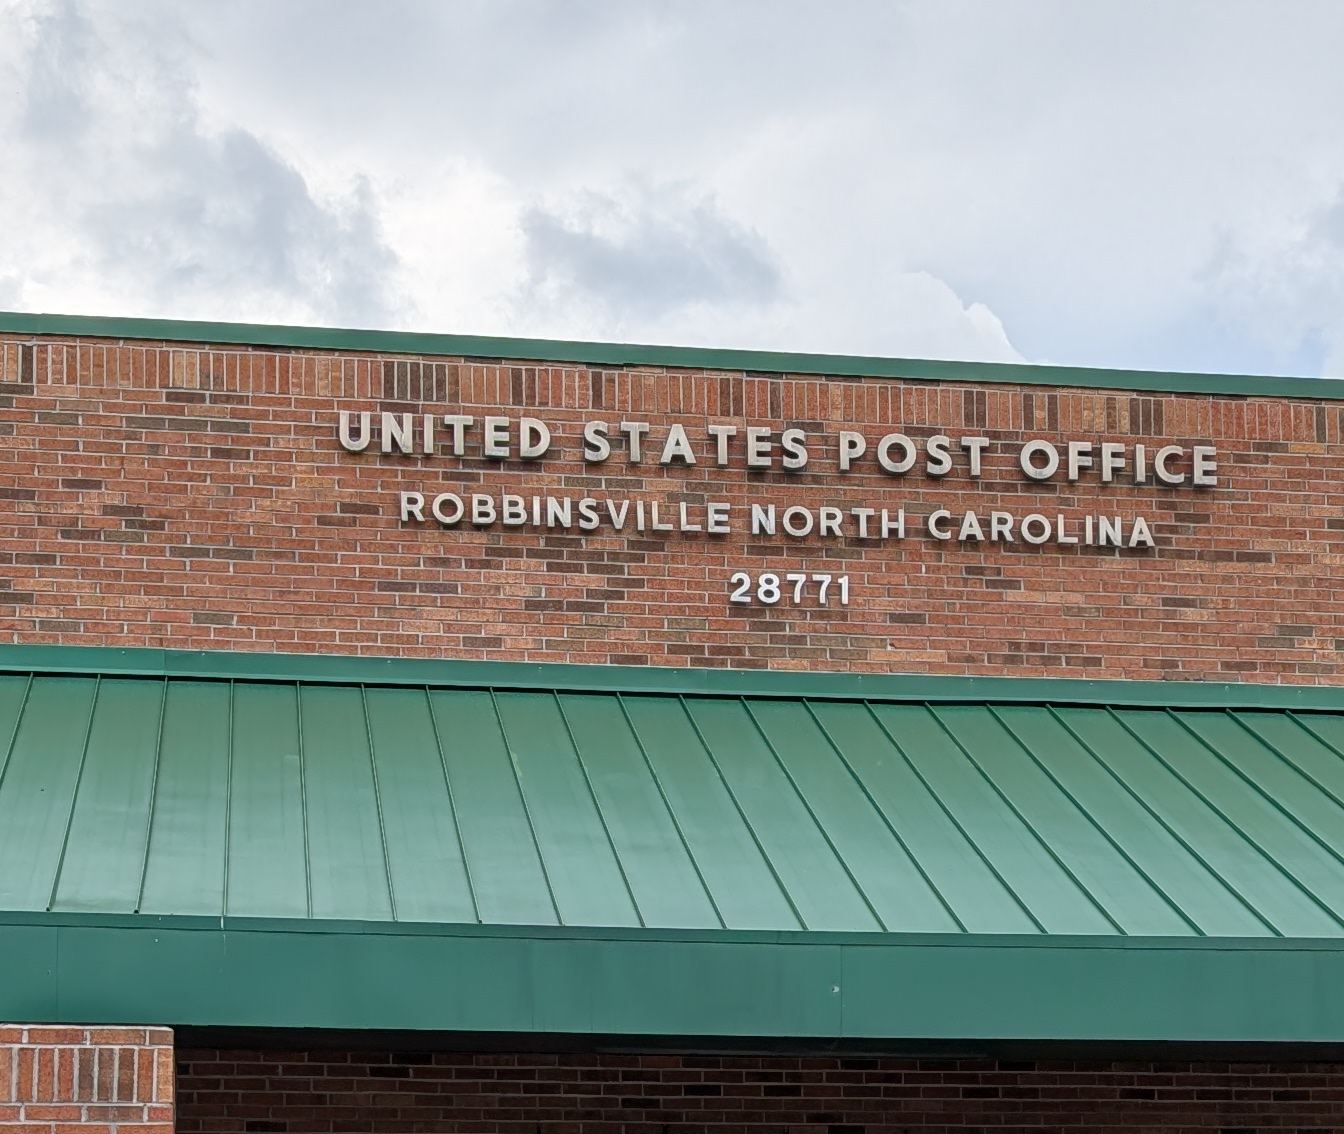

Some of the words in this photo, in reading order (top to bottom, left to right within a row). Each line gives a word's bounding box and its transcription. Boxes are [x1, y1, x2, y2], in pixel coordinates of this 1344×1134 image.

[339, 410, 551, 459] UNITED
[583, 420, 808, 469] STATES
[839, 430, 990, 477] POST
[1019, 439, 1218, 486] OFFICE
[400, 490, 731, 534] ROBBINSVILLE
[751, 503, 906, 539] NORTH
[927, 509, 1156, 548] CAROLINA
[729, 571, 850, 606] 28771
